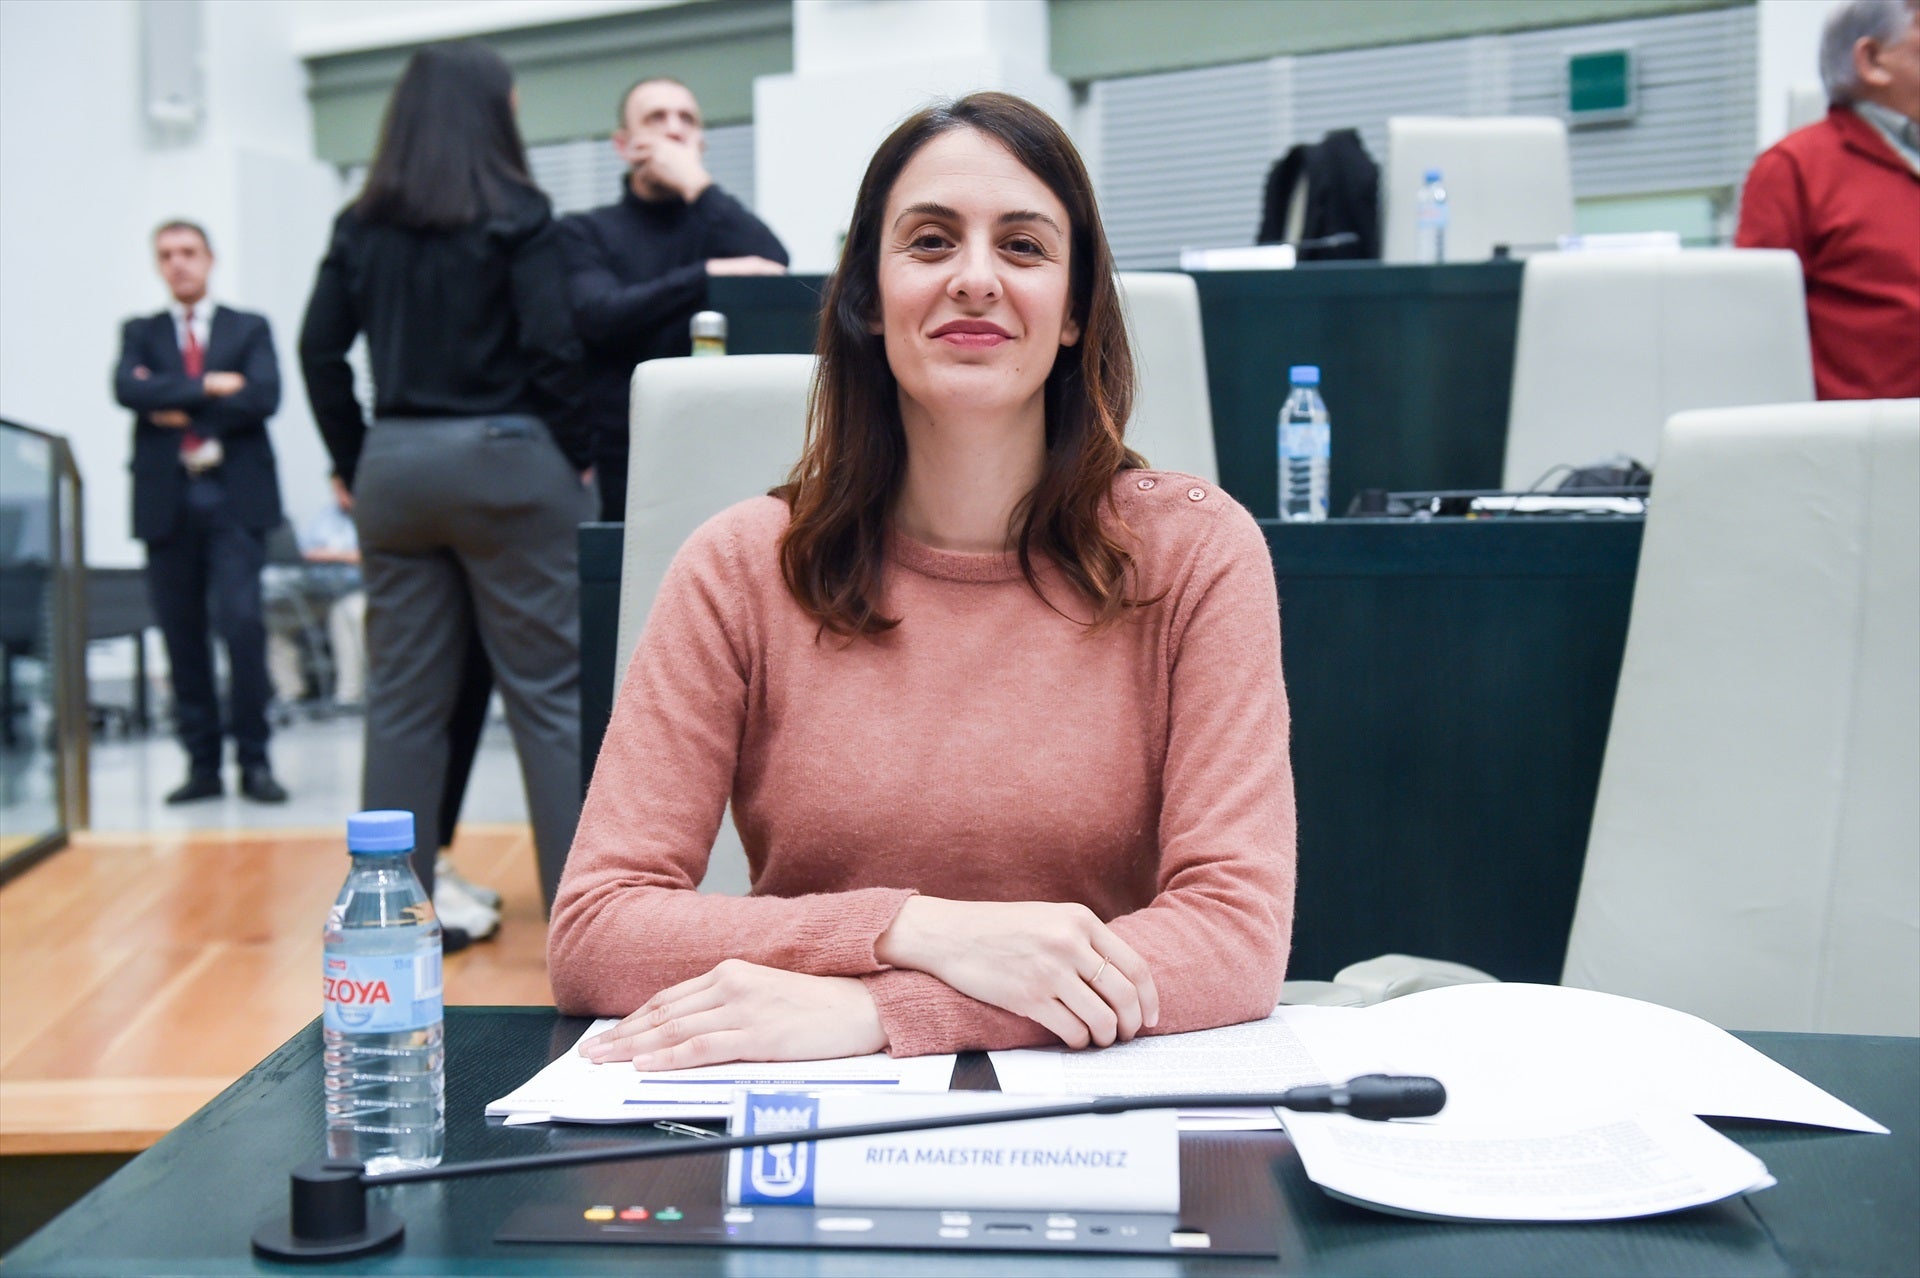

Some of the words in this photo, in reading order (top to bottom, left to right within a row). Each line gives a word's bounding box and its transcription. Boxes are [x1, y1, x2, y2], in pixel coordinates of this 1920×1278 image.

[866, 1147, 910, 1165] RITA
[914, 1148, 1003, 1167] MAESTRE
[1010, 1145, 1128, 1169] FERNÁNDEZ
